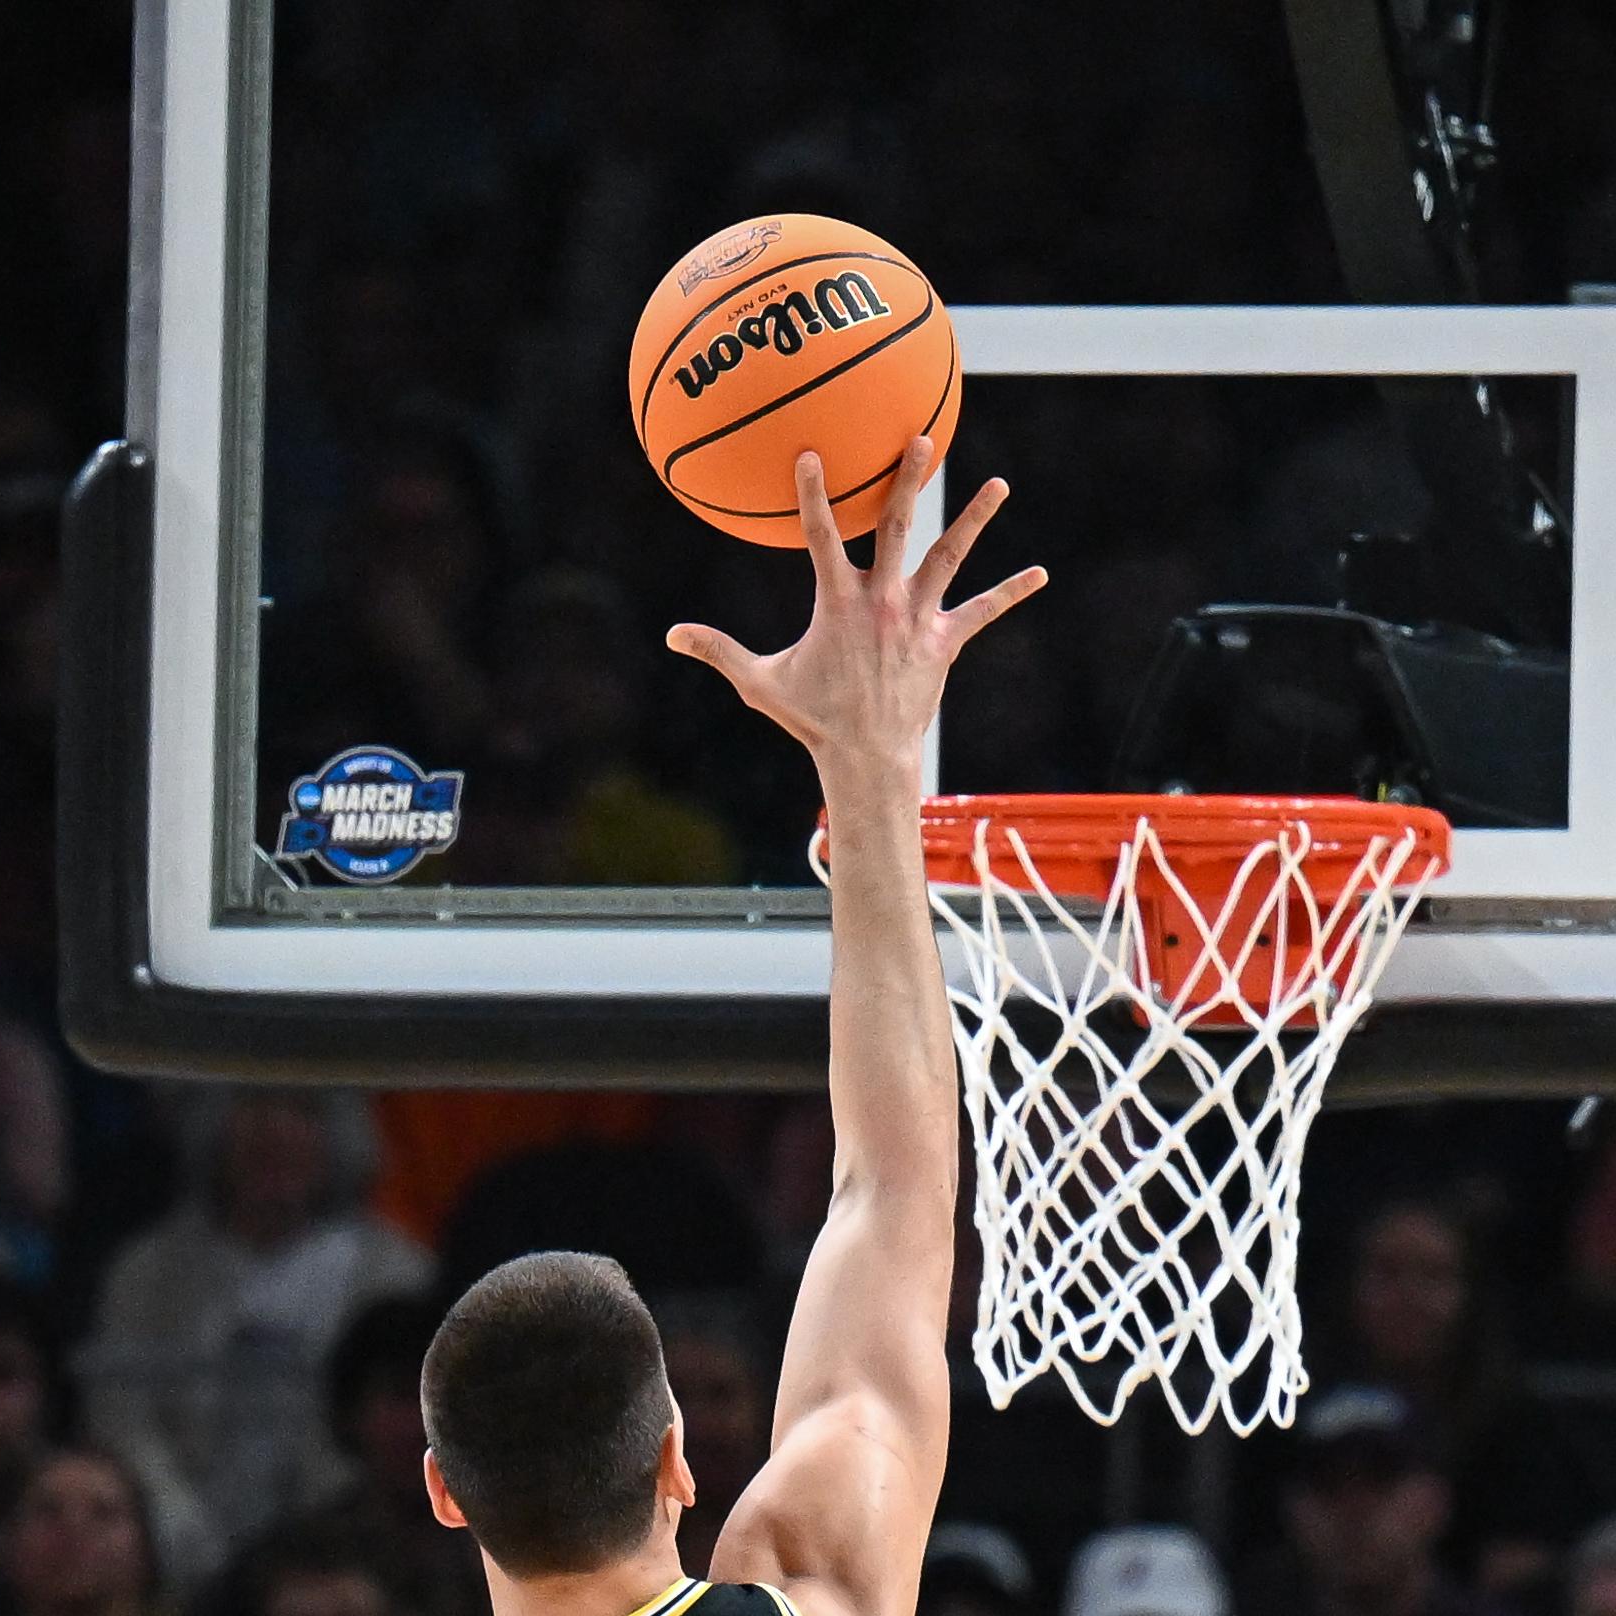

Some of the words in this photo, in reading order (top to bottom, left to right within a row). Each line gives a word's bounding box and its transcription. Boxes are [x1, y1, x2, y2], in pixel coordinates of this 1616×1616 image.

[758, 284, 788, 303] EVO
[727, 299, 755, 322] NXT
[674, 270, 892, 399] Wilson
[321, 783, 413, 813] MARCH
[331, 811, 453, 841] MADNESS
